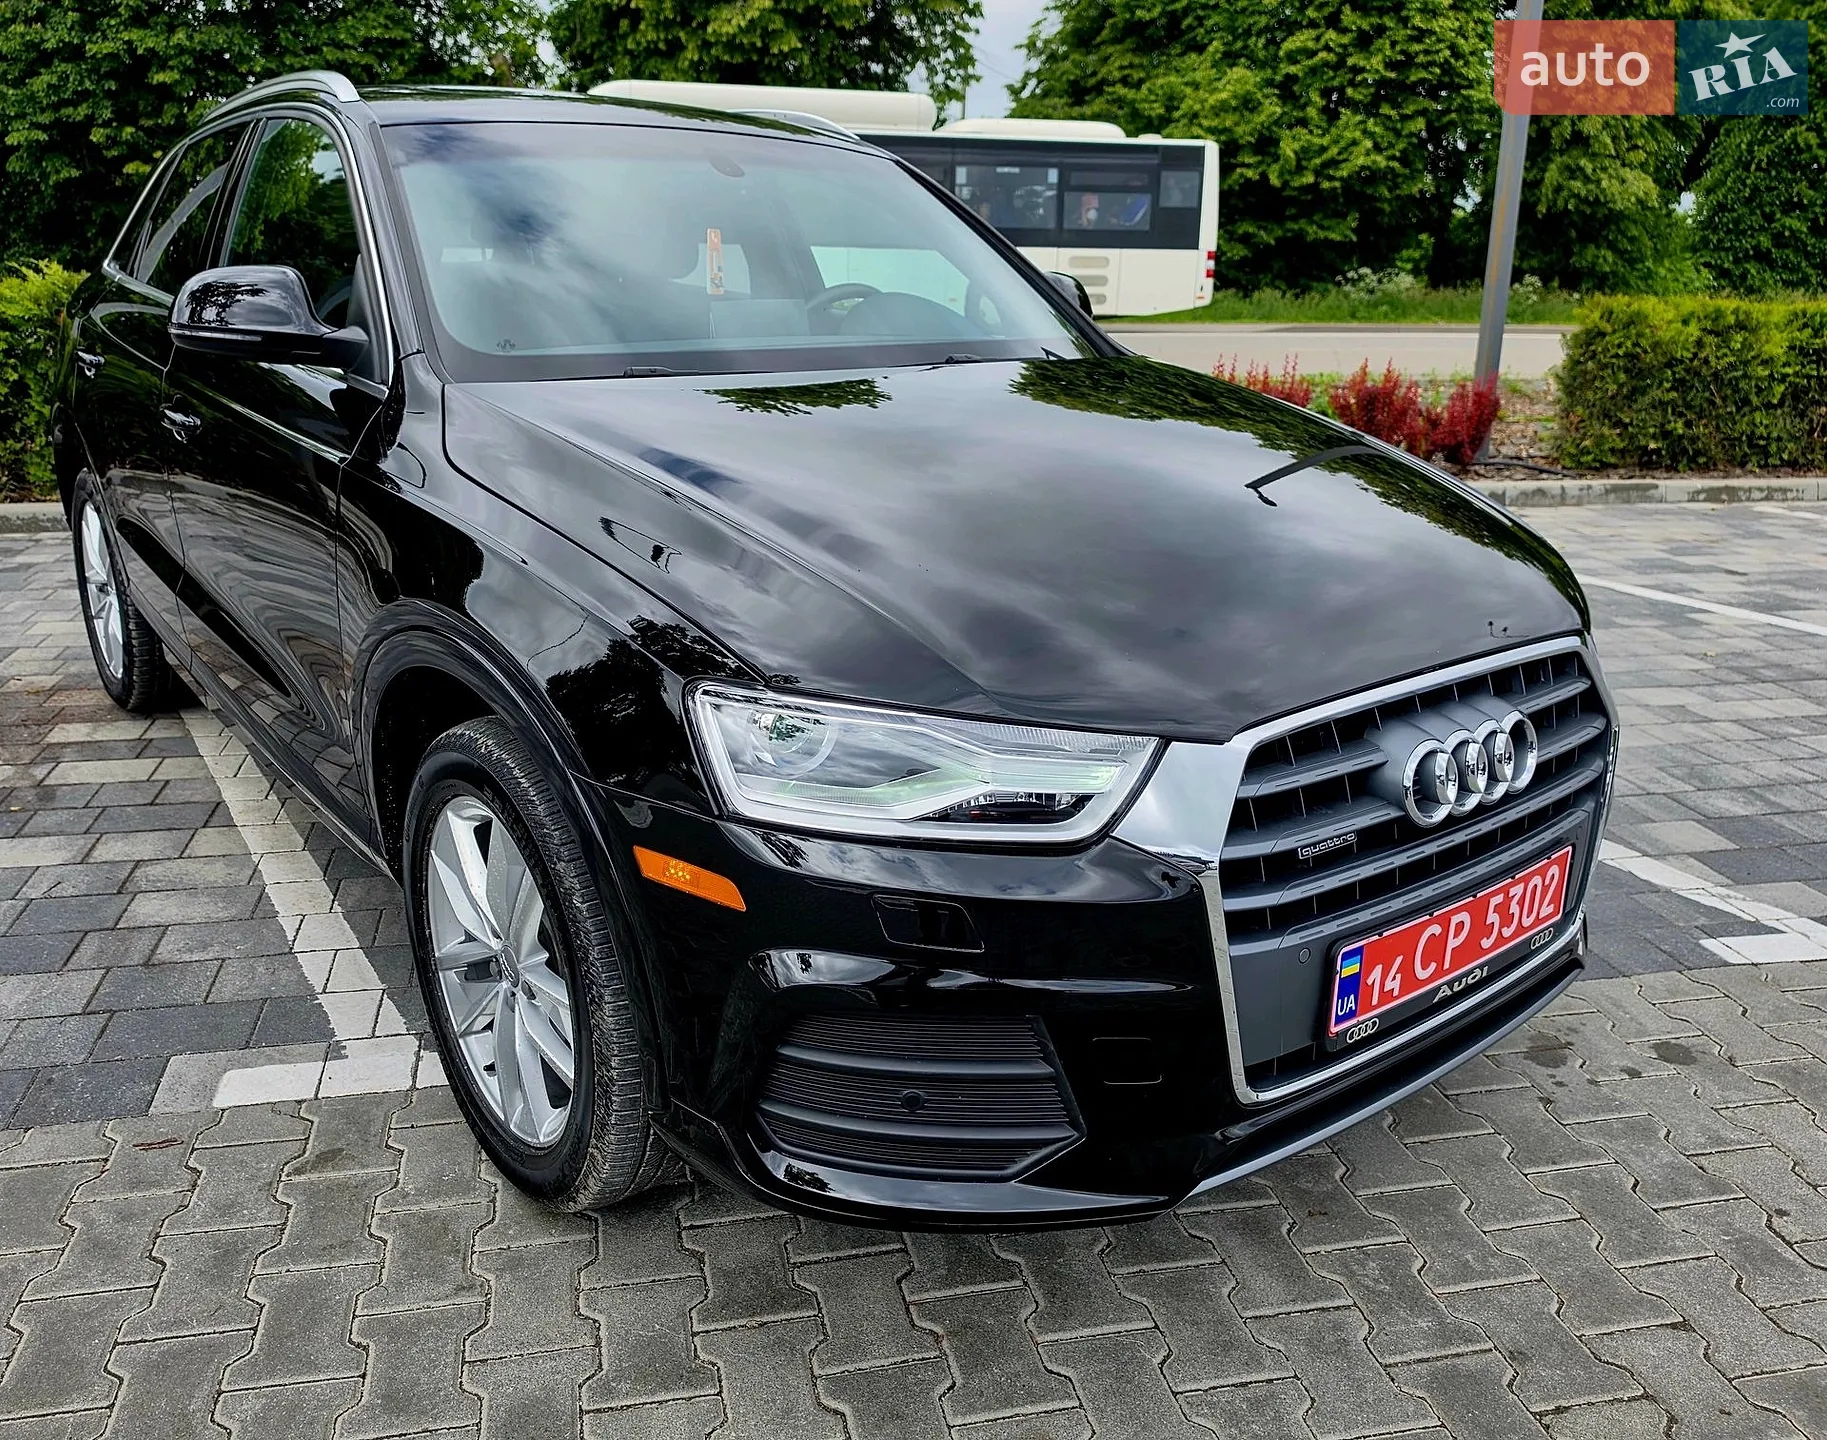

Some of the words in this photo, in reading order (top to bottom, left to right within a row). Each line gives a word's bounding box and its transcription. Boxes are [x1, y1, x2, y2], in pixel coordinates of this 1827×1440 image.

[1301, 832, 1355, 856] quattro
[1366, 955, 1404, 1007] 14
[1414, 910, 1471, 980] CP
[1479, 864, 1560, 950] 5302
[1432, 965, 1489, 1003] Audi
[1337, 993, 1356, 1016] UA
